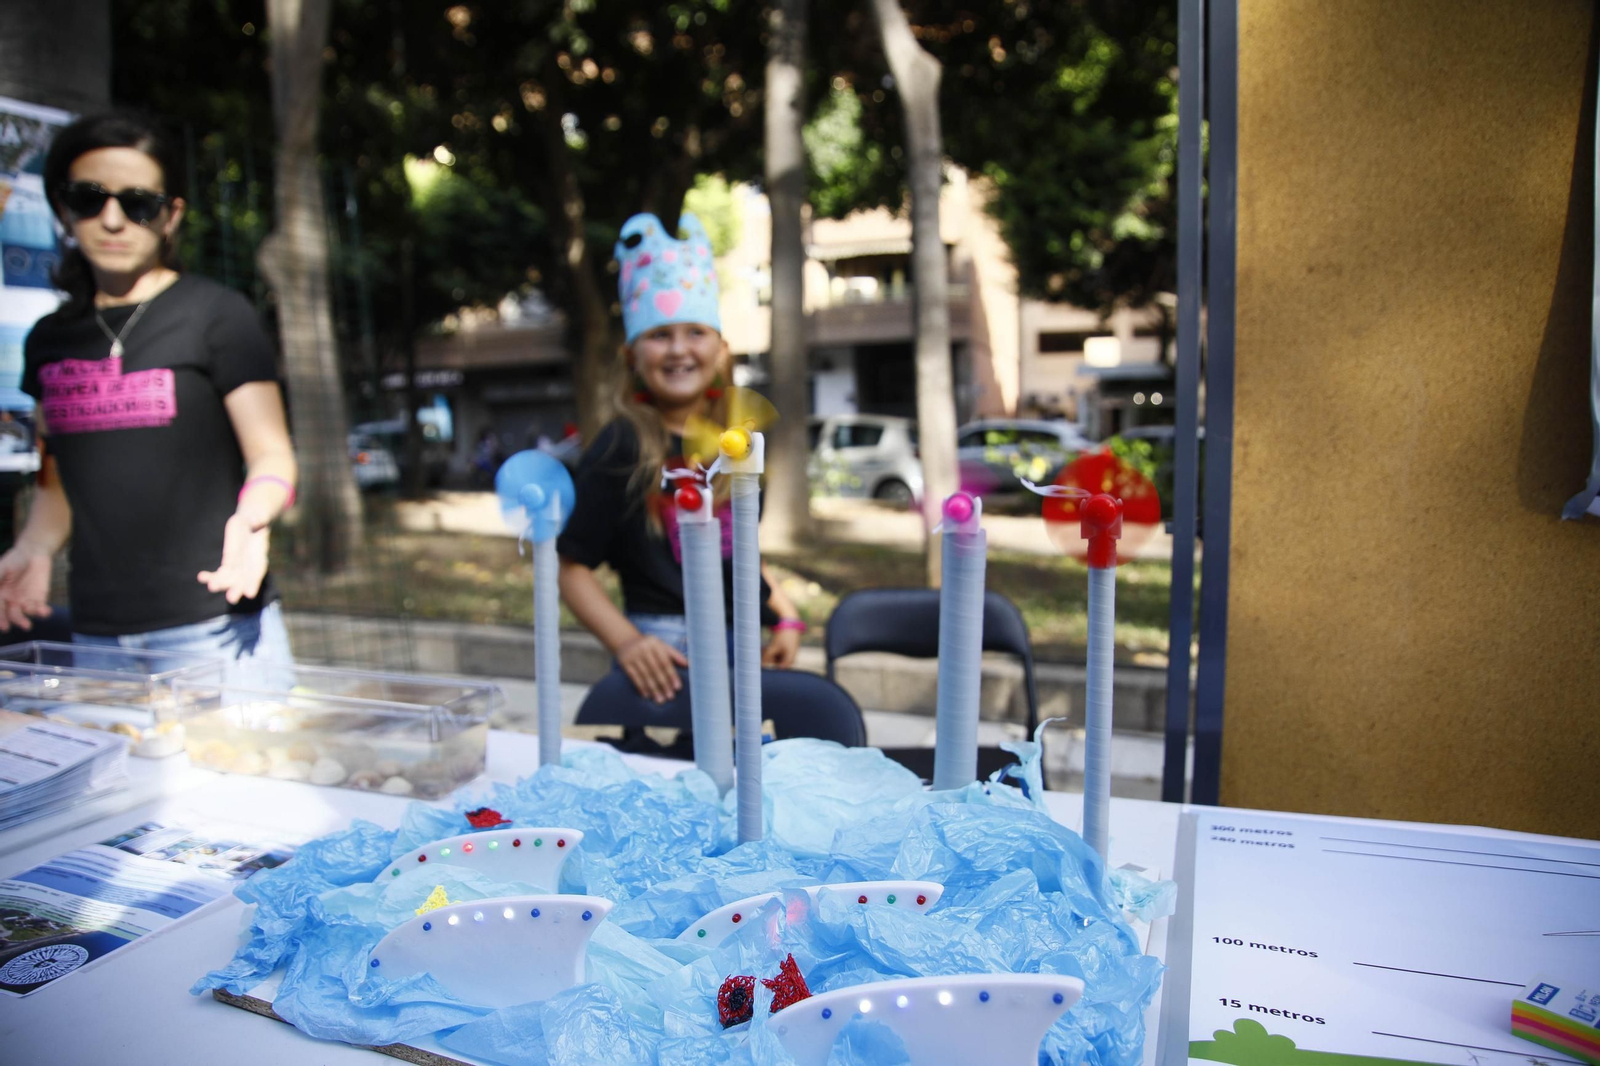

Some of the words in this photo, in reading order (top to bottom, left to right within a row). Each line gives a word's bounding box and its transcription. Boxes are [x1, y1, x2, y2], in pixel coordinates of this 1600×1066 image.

[1239, 828, 1293, 836] metros
[1240, 839, 1295, 849] metros
[1212, 936, 1243, 946] 100
[1249, 942, 1319, 958] metros
[1219, 998, 1242, 1008] 15
[1248, 1003, 1326, 1024] metros
